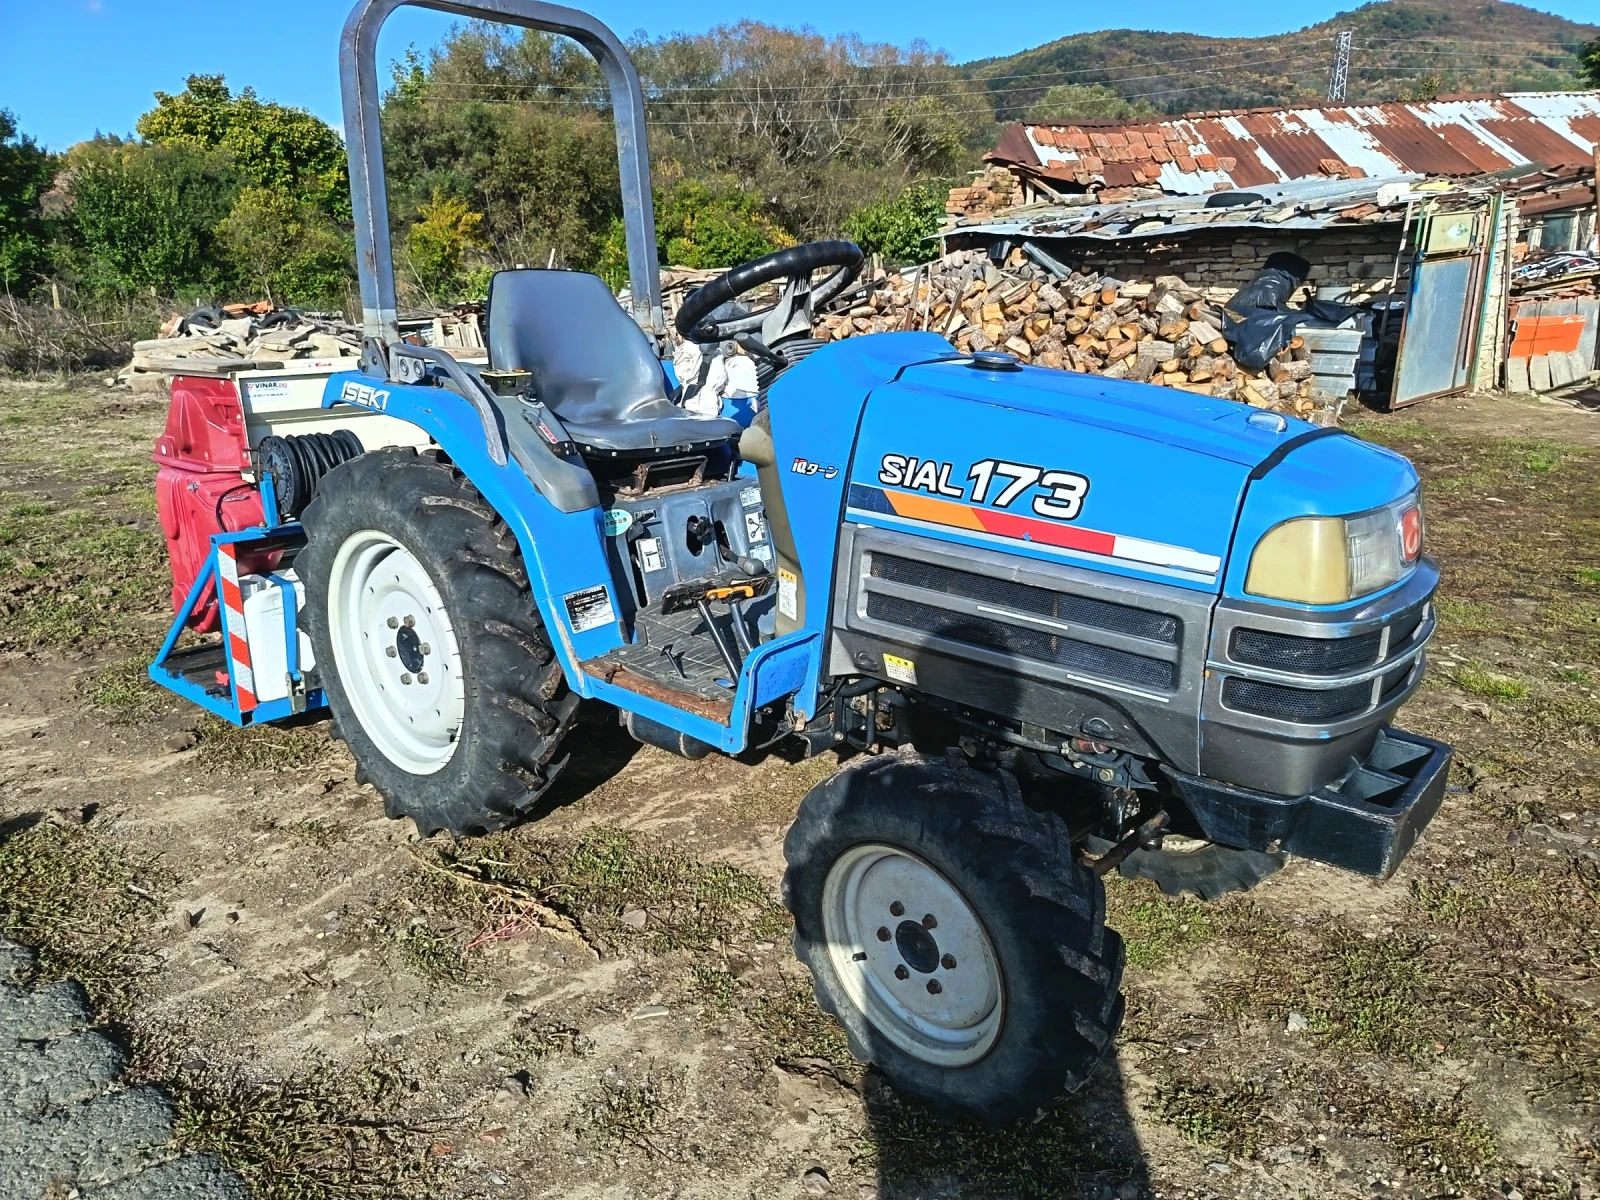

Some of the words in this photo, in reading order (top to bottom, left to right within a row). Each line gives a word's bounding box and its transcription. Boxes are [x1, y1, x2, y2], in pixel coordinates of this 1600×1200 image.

[340, 380, 391, 411] ISEKI
[878, 453, 965, 498] SIAL
[966, 457, 1091, 520] 173
